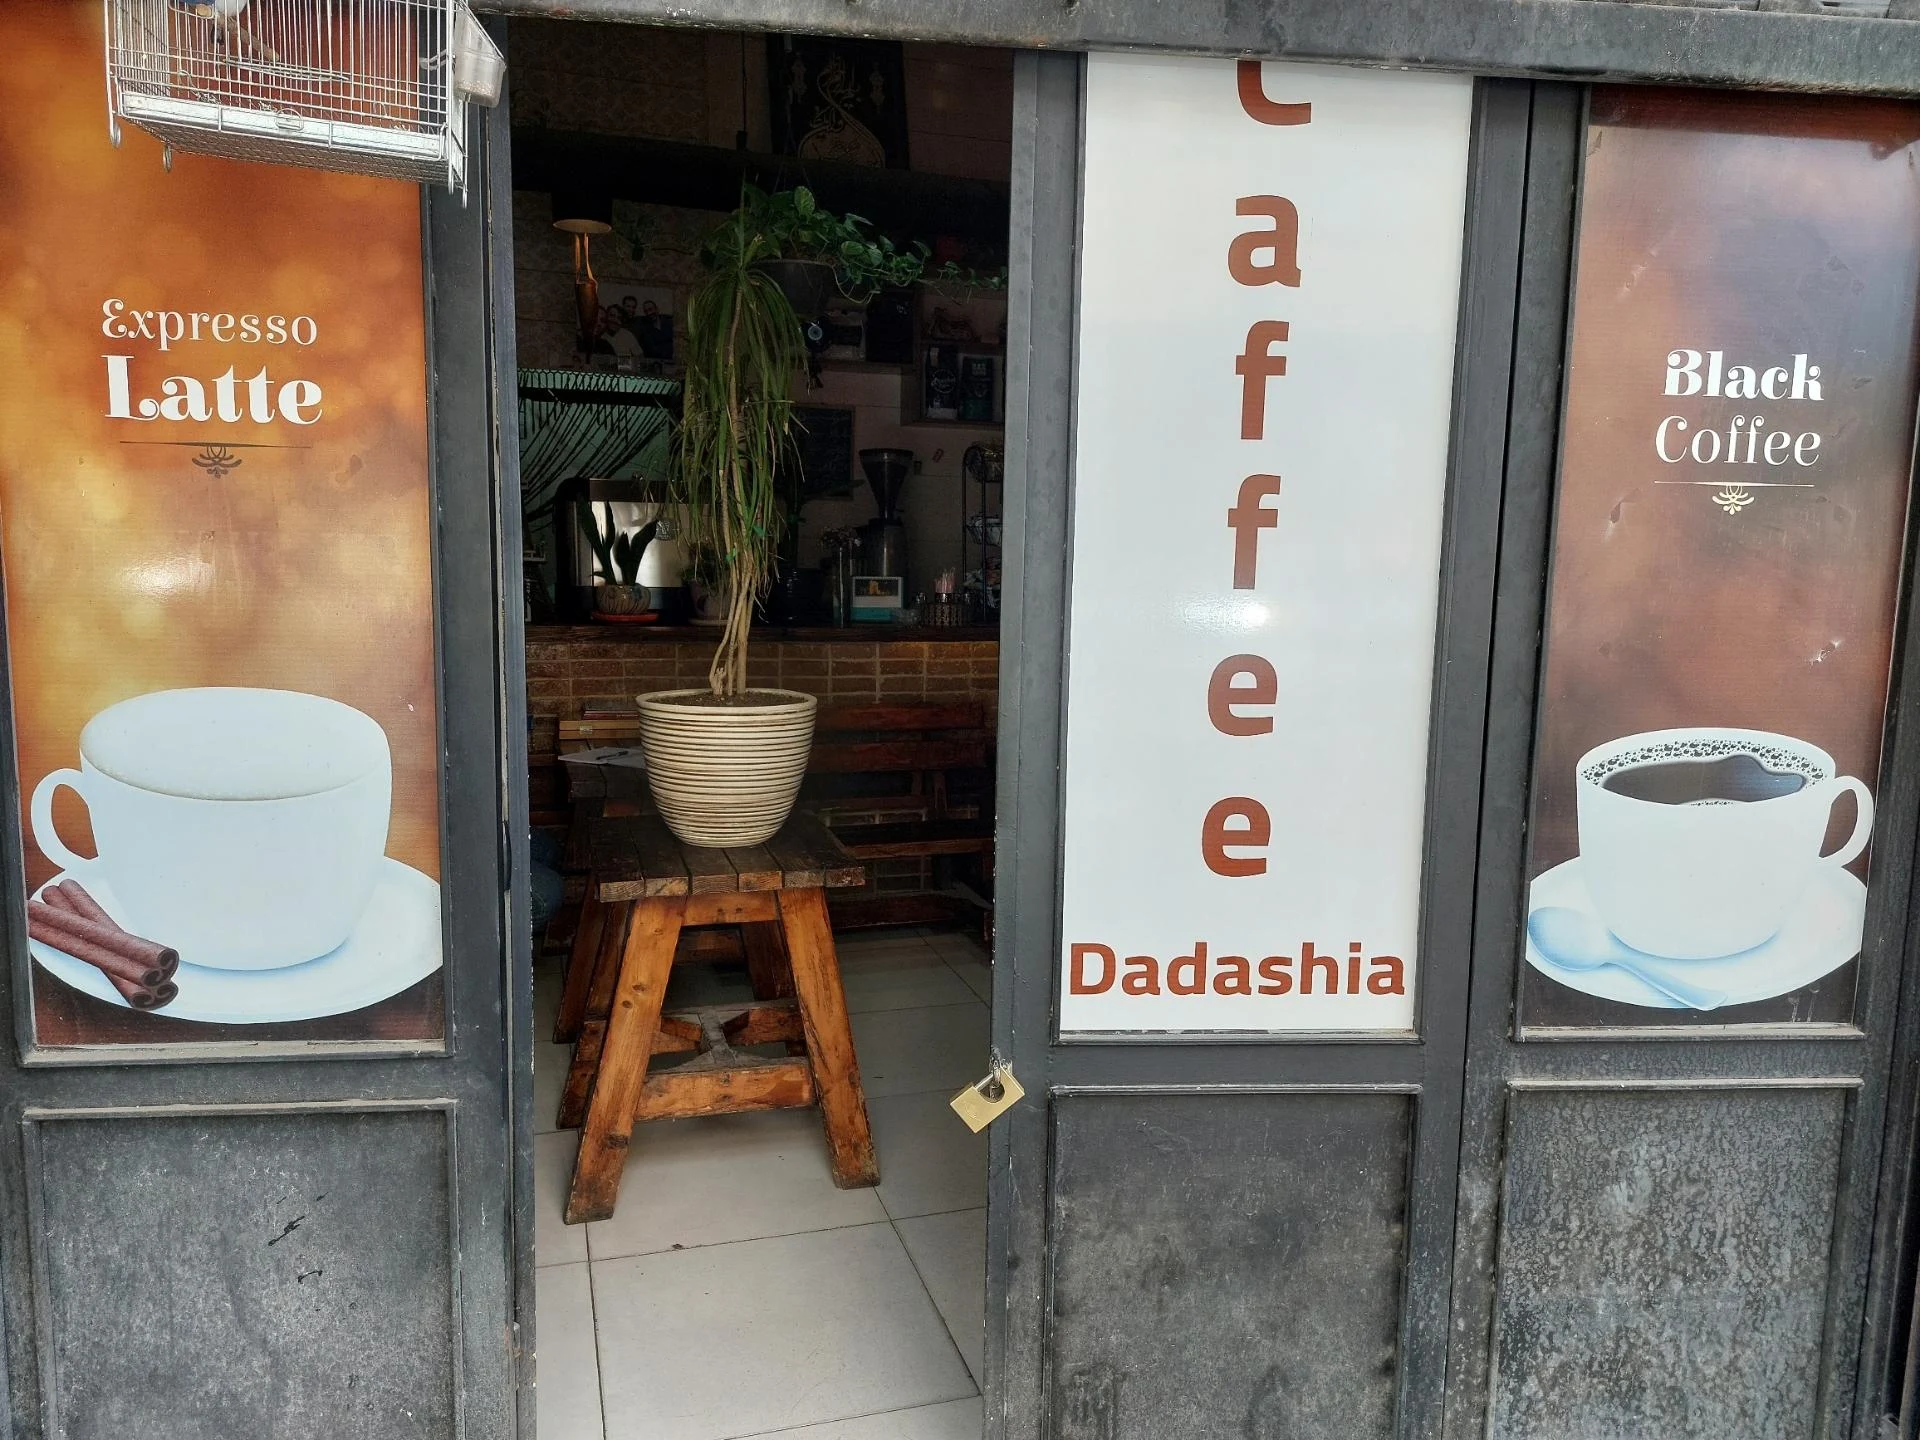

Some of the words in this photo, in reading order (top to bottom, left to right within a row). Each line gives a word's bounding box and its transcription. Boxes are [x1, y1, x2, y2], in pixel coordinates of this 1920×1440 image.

[101, 298, 319, 351] Expresso
[101, 354, 323, 425] Latte
[1660, 349, 1825, 401] Black
[1654, 414, 1822, 467] Coffee
[1069, 942, 1405, 997] Dadashia
